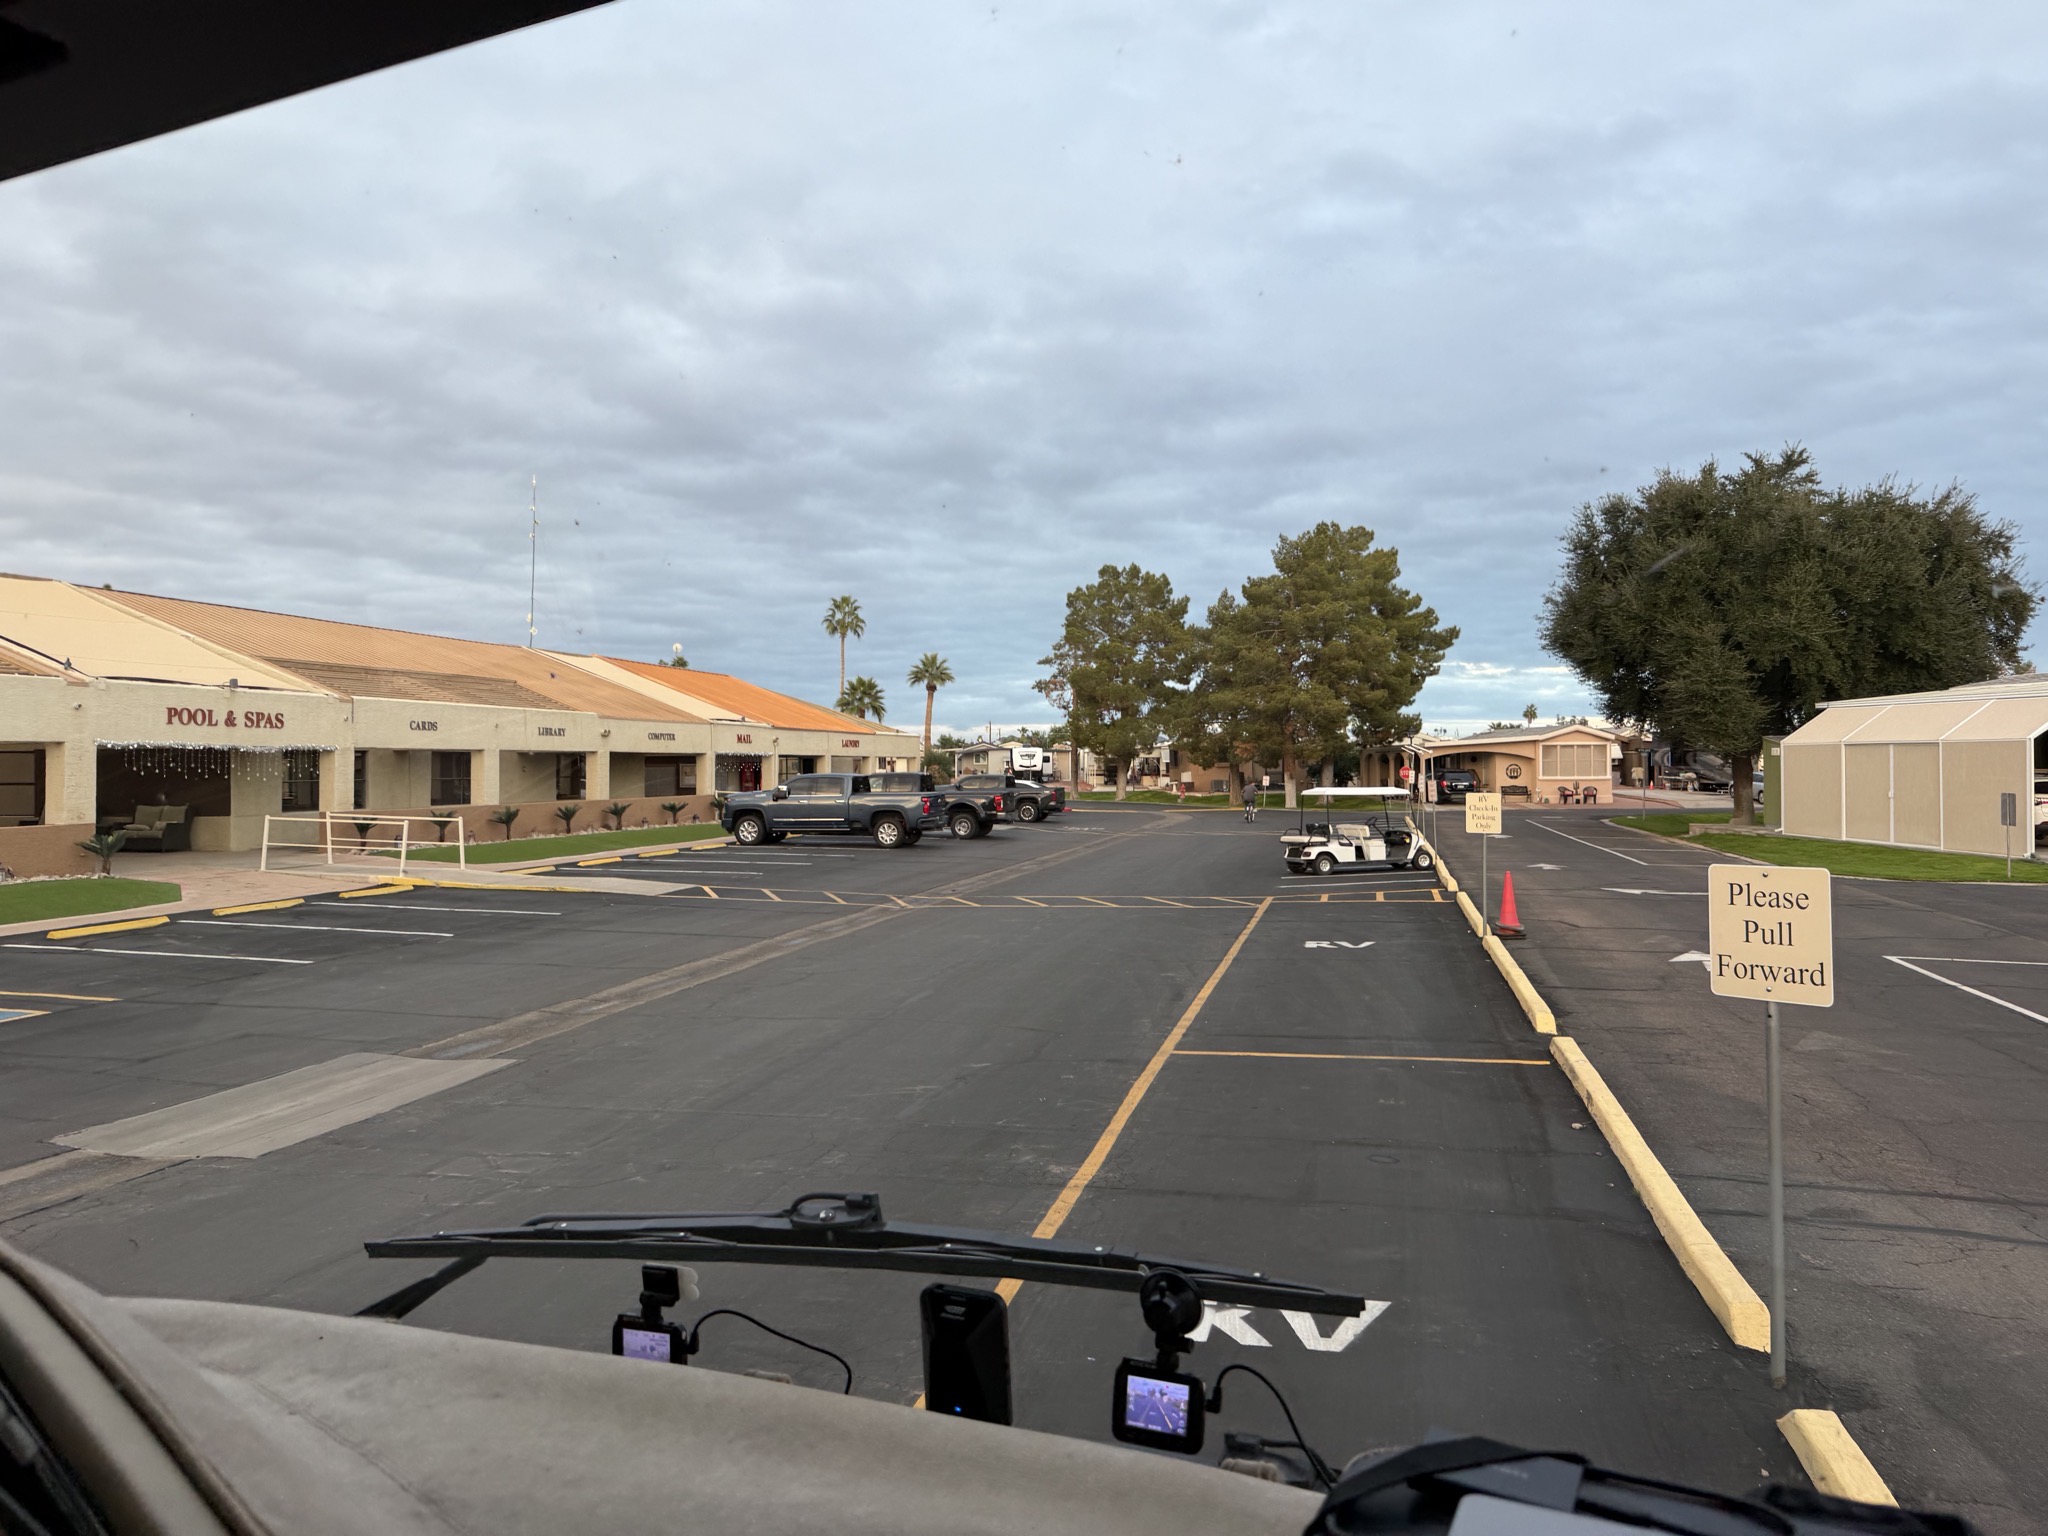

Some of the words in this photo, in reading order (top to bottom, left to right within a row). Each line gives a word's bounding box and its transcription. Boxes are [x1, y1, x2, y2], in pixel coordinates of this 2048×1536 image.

[166, 707, 218, 727] POOL
[224, 710, 237, 727] &
[244, 711, 285, 729] SPAS
[409, 720, 438, 731] CARDS
[538, 727, 566, 736] LIBRARY
[648, 732, 675, 741] COMPUTER
[736, 734, 752, 744] MAIL
[1472, 813, 1496, 821] Parking
[1727, 882, 1810, 910] Please
[1742, 919, 1795, 946] Pull
[1304, 940, 1376, 949] RV
[1716, 953, 1826, 987] Forward
